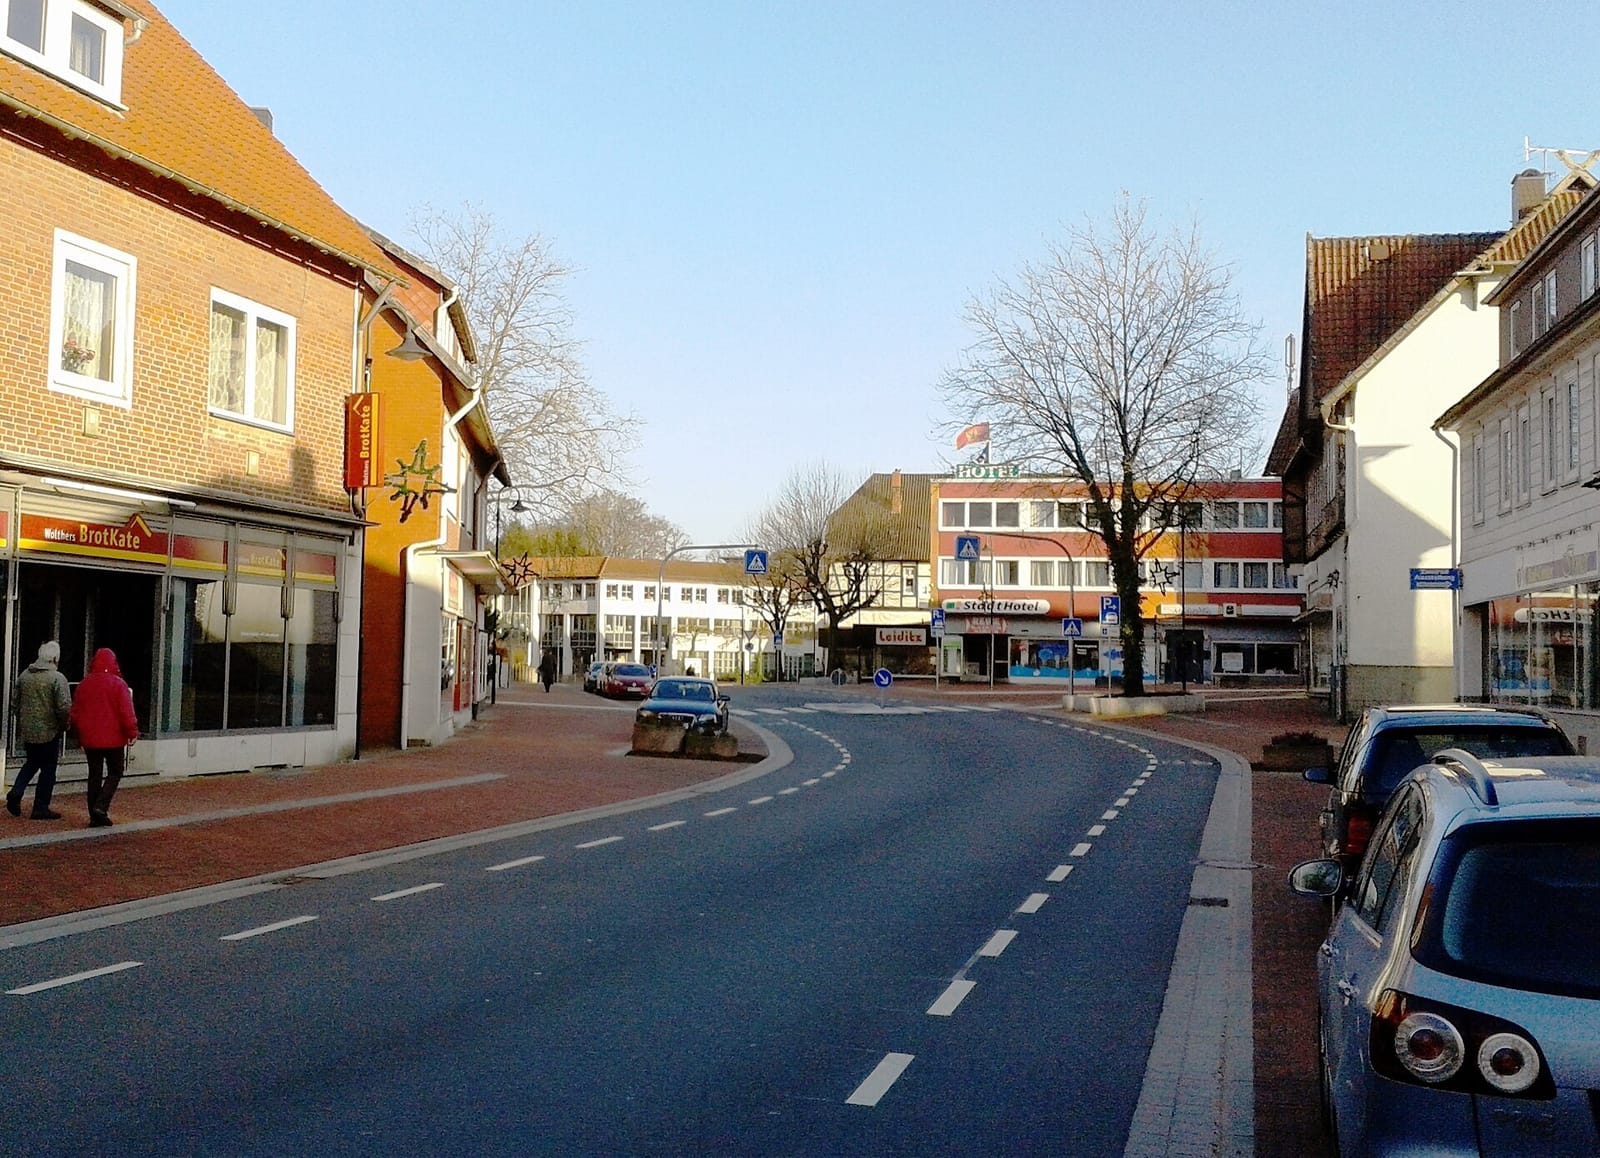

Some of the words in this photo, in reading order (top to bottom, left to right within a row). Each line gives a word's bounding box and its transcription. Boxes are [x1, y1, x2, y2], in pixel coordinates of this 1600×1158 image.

[359, 405, 371, 459] BrotKate
[958, 465, 1020, 479] HOTEL
[44, 527, 76, 542] Wolthers
[79, 524, 141, 549] BrotKate
[879, 630, 923, 643] Leiditz
